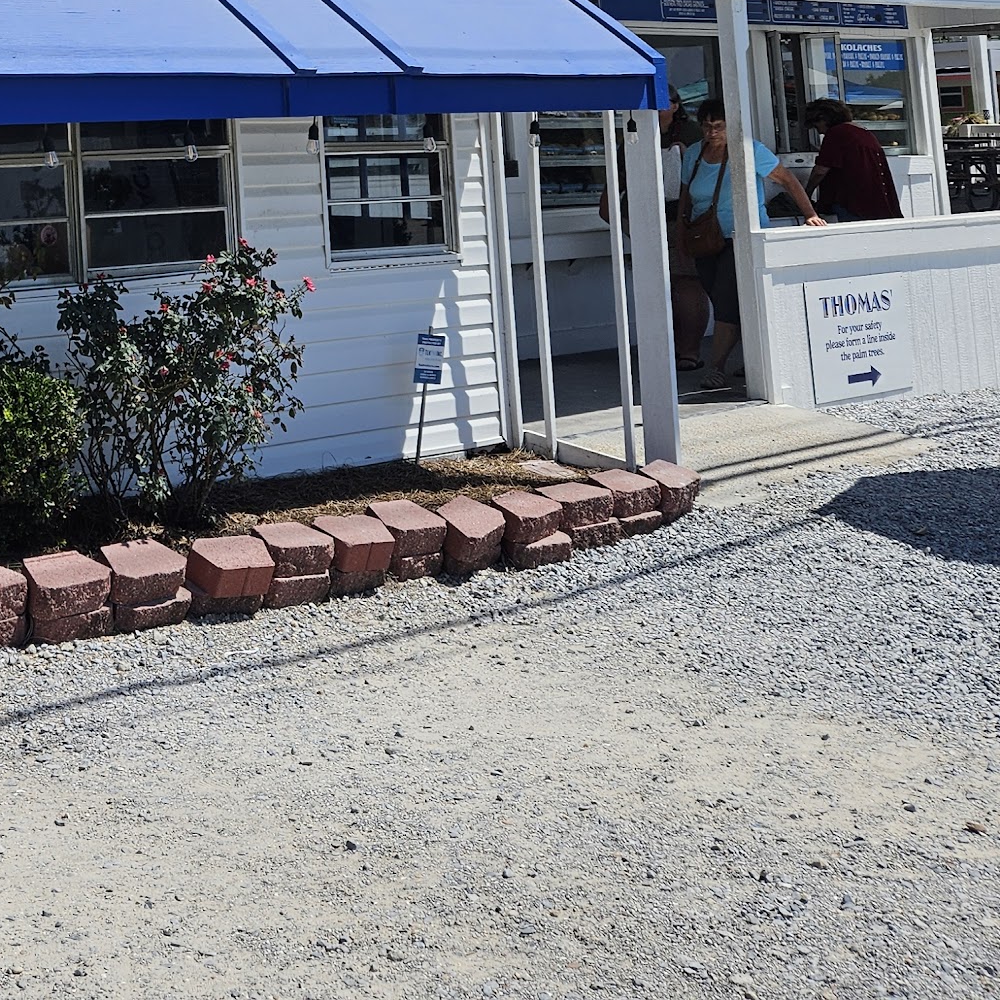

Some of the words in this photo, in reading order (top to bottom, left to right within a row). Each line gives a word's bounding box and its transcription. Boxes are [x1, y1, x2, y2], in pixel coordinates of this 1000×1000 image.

[841, 43, 883, 52] KOLACHES
[819, 289, 893, 319] THOMAS'
[837, 325, 848, 335] For
[849, 322, 864, 335] your
[864, 320, 882, 331] safety
[825, 339, 845, 353] please
[846, 336, 861, 348] form
[862, 337, 866, 345] a
[866, 334, 878, 344] line
[879, 331, 895, 342] inside
[841, 351, 851, 361] the
[852, 348, 868, 362] palm
[868, 348, 885, 357] trees.
